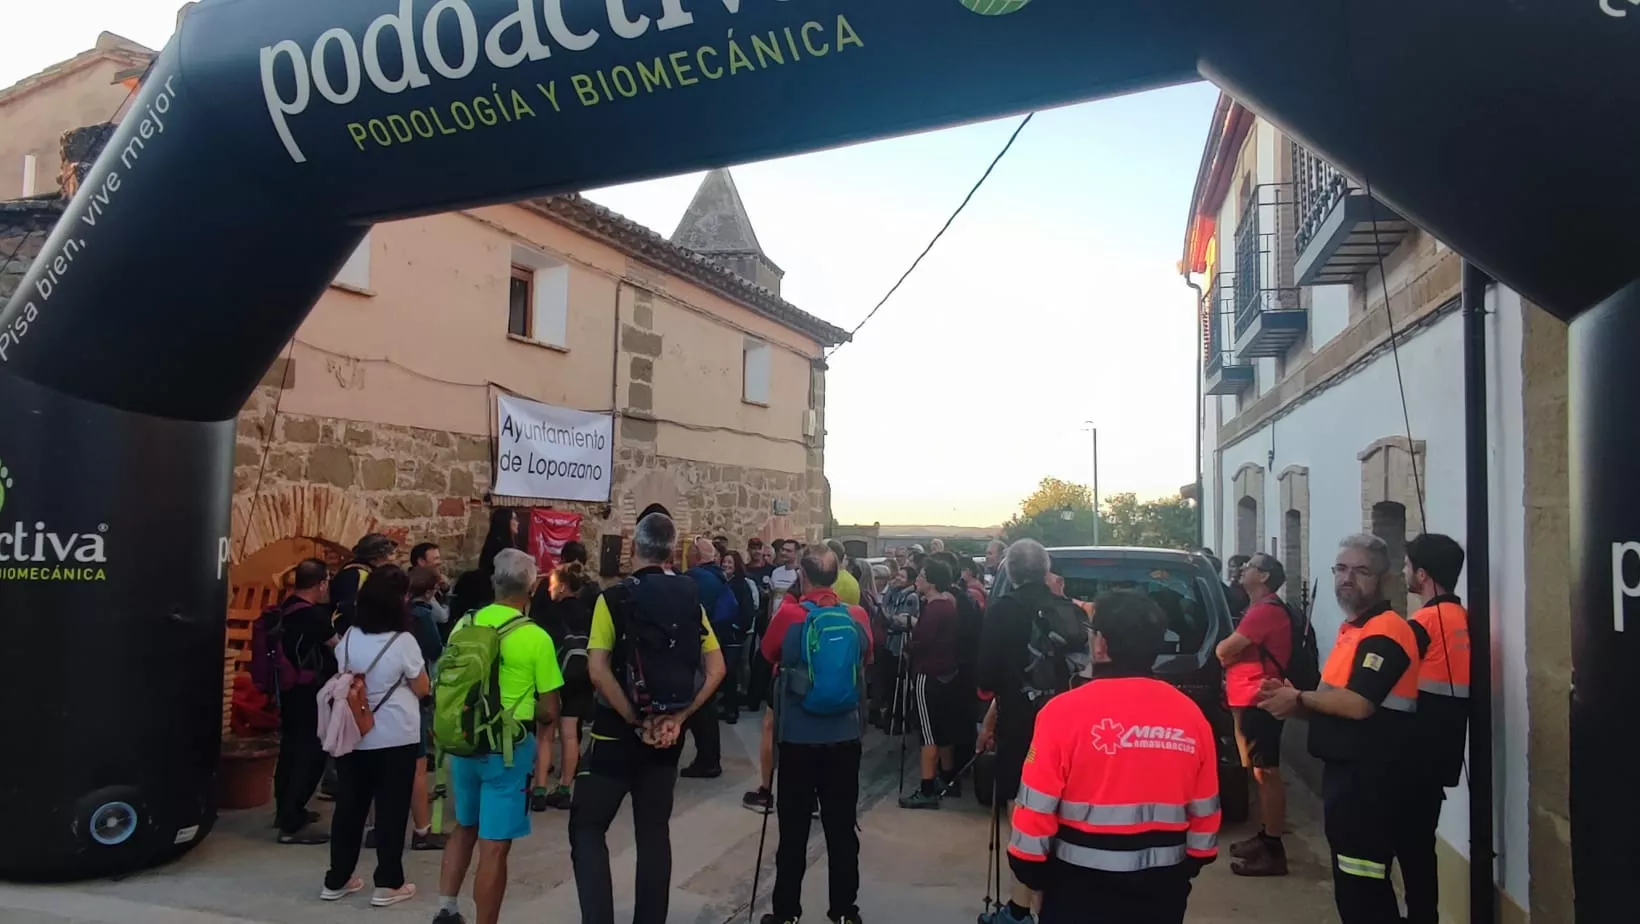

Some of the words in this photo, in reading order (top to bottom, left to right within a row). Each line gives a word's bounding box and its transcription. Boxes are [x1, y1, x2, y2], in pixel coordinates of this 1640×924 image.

[347, 83, 536, 151] PODOLOGÍA
[536, 80, 561, 113] Y
[571, 14, 864, 106] BIOMECÁNICA
[0, 302, 38, 361] Pisa
[36, 238, 86, 300] bien,
[82, 171, 121, 226] vive
[121, 75, 176, 169] mejor
[501, 414, 605, 450] Ayuntamiento
[500, 449, 523, 472] de
[528, 452, 602, 480] Loporzano
[0, 564, 107, 581] IOMECÁNICA
